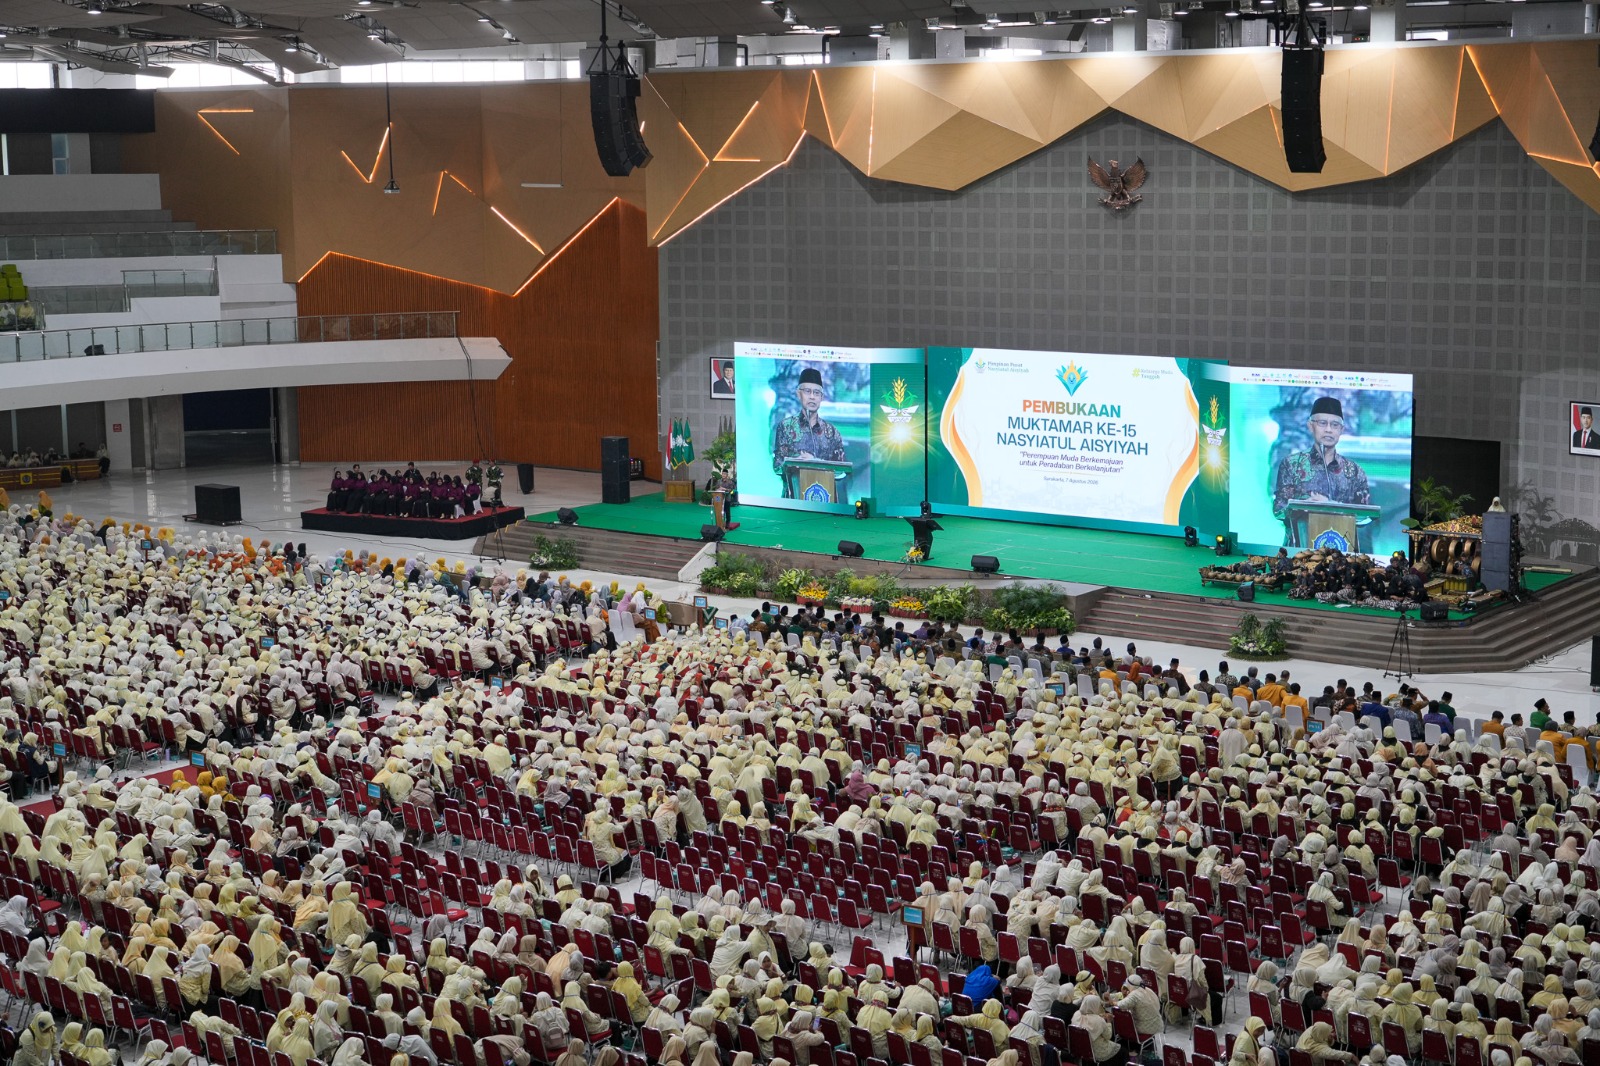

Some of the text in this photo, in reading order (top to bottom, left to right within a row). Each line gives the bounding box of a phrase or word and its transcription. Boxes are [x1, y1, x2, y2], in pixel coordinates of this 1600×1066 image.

[1022, 399, 1121, 418] PEMBUKAAN
[1008, 416, 1136, 438] MUKTAMAR KE-15
[997, 432, 1148, 456] NASYIATUL AISYIYAH
[1020, 451, 1124, 466] "Perempuan Muda Berkemajuan
[1039, 460, 1074, 470] Peradaban
[1075, 463, 1124, 474] Berkelanjutan"
